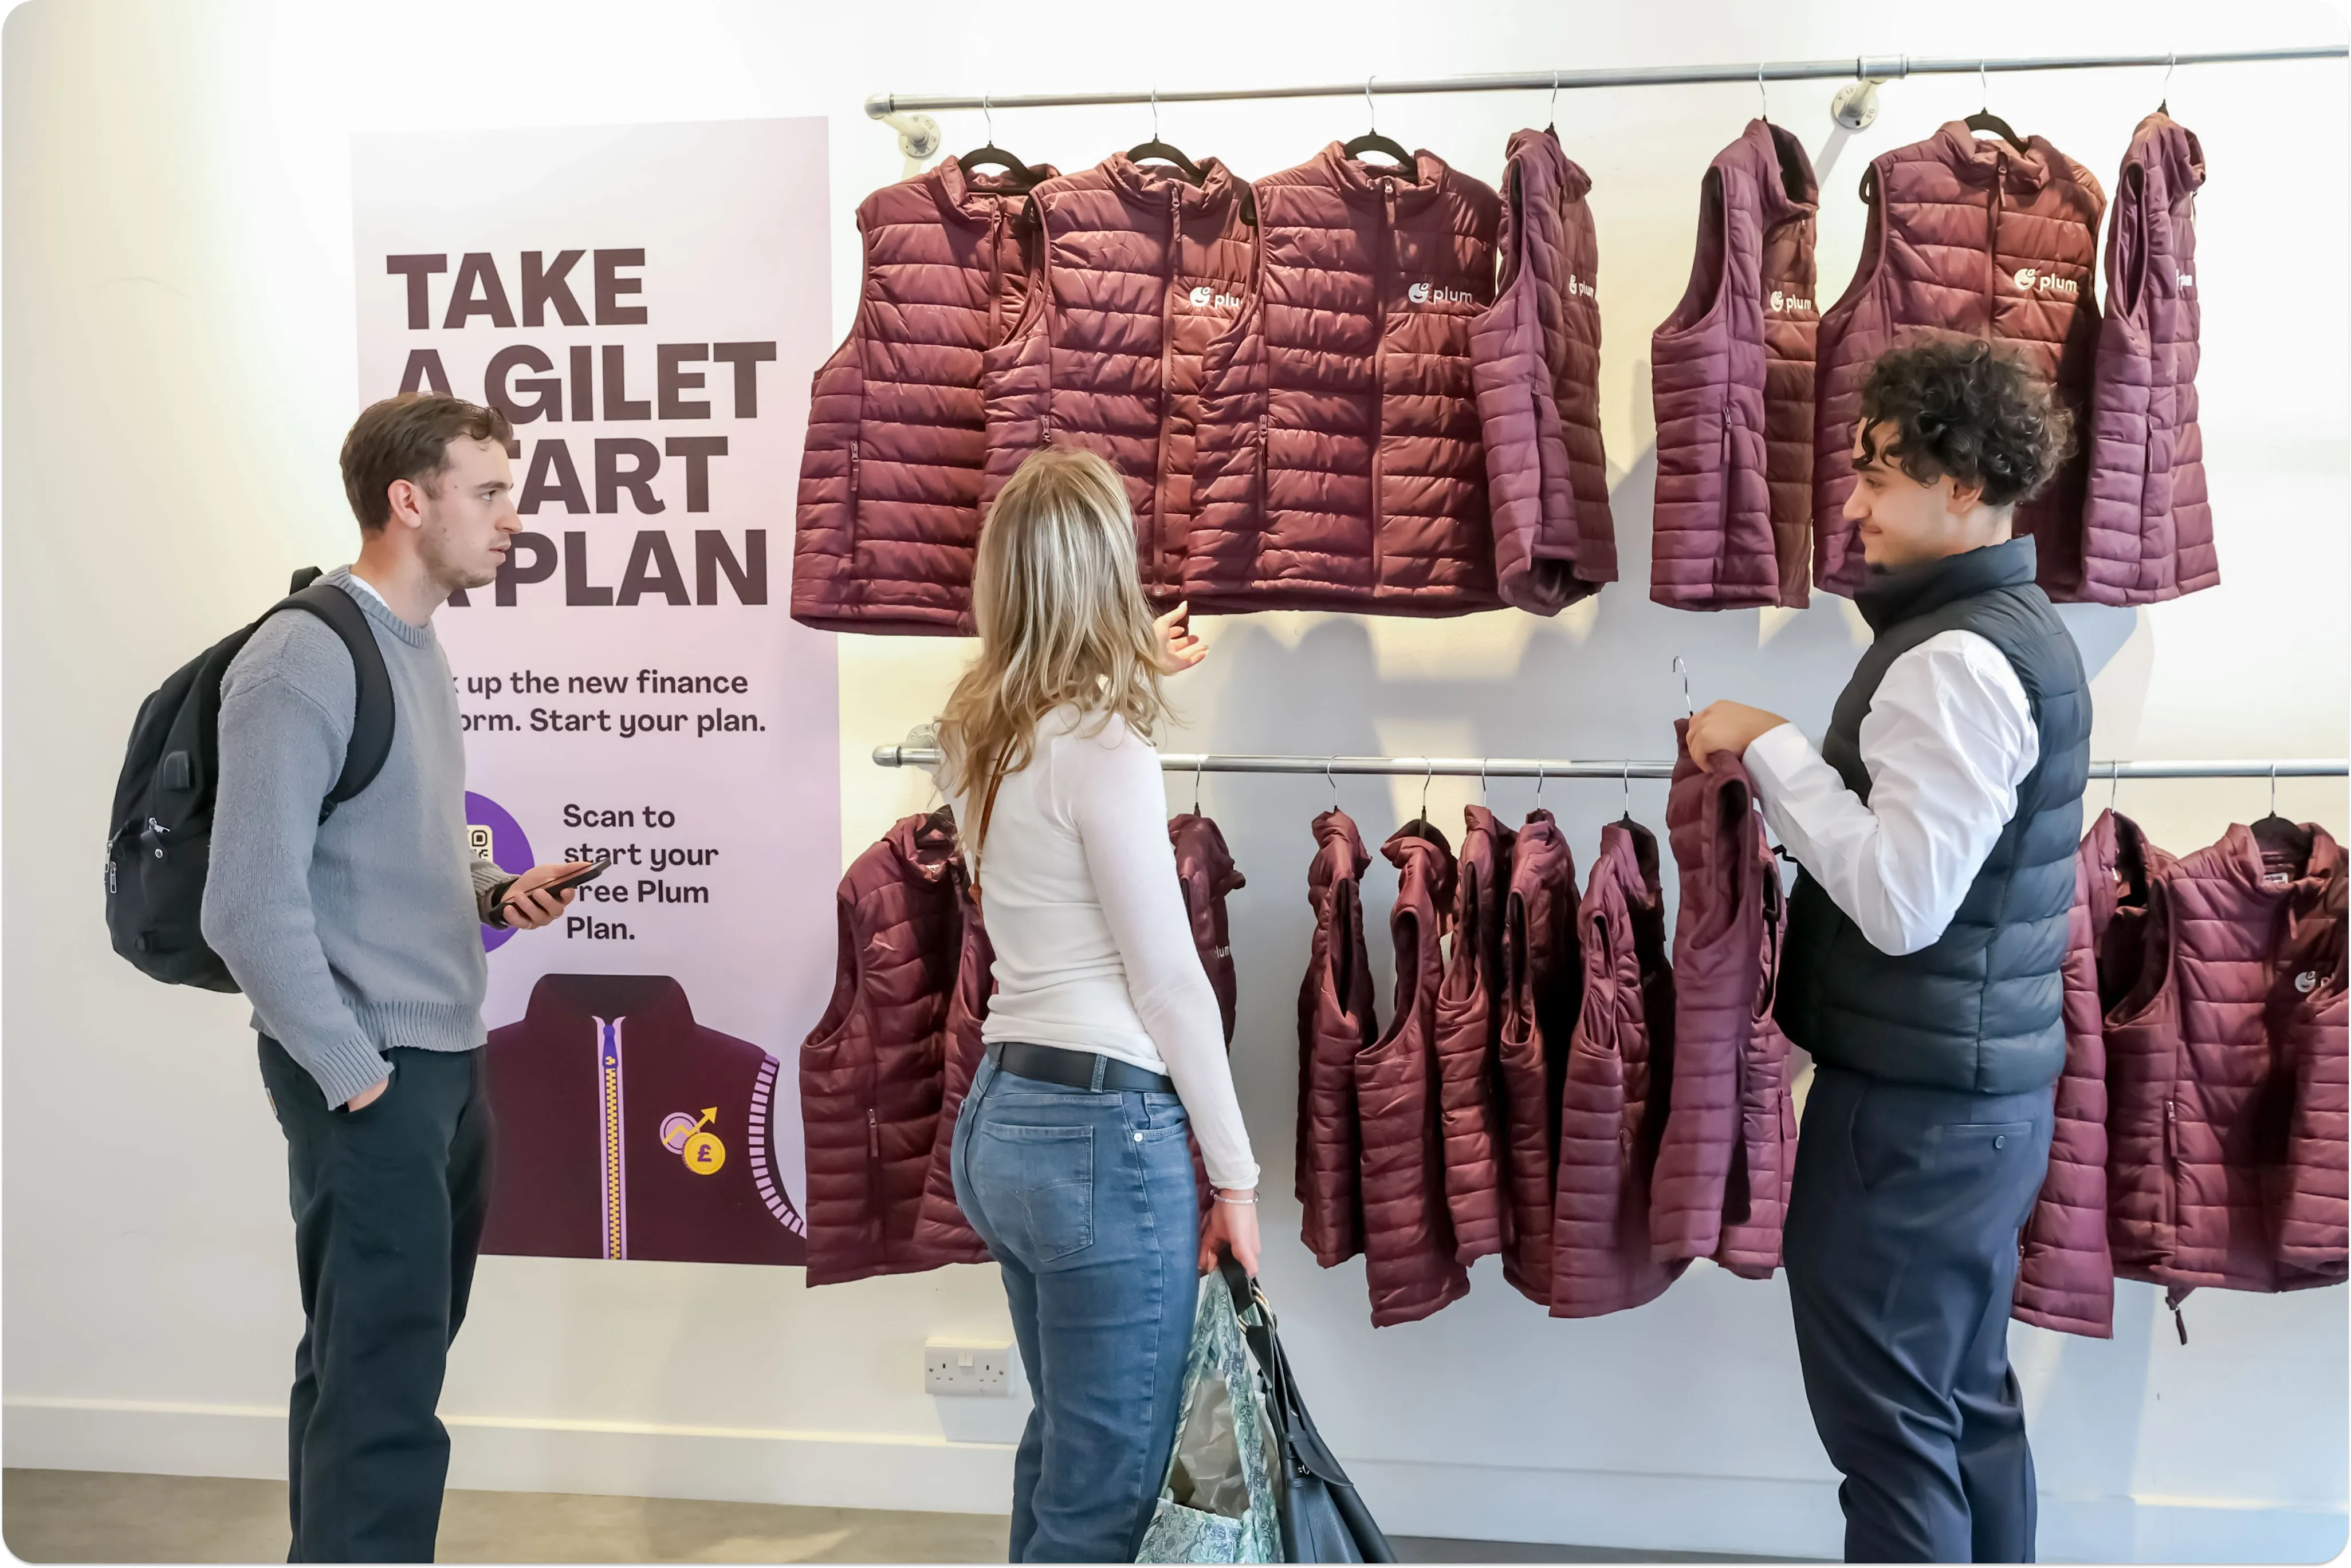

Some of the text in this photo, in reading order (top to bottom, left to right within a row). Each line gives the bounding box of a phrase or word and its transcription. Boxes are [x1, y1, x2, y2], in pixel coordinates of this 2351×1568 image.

[387, 249, 648, 330] TAKE
[1433, 286, 1472, 305] plum
[2040, 273, 2077, 293] plum
[1215, 291, 1244, 309] plu
[1786, 294, 1811, 313] plum
[485, 341, 777, 424] GILET
[508, 436, 728, 515] ART
[494, 526, 768, 607] PLAN
[467, 676, 502, 700] up
[510, 669, 560, 694] the
[568, 676, 628, 694] new
[636, 669, 748, 694] finance
[530, 708, 612, 732] Start
[619, 714, 689, 738] your
[697, 707, 766, 738] plan.
[563, 803, 675, 828] Scan to
[564, 843, 720, 872] start your
[575, 879, 709, 904] ree Plum
[567, 916, 635, 940] Plan.
